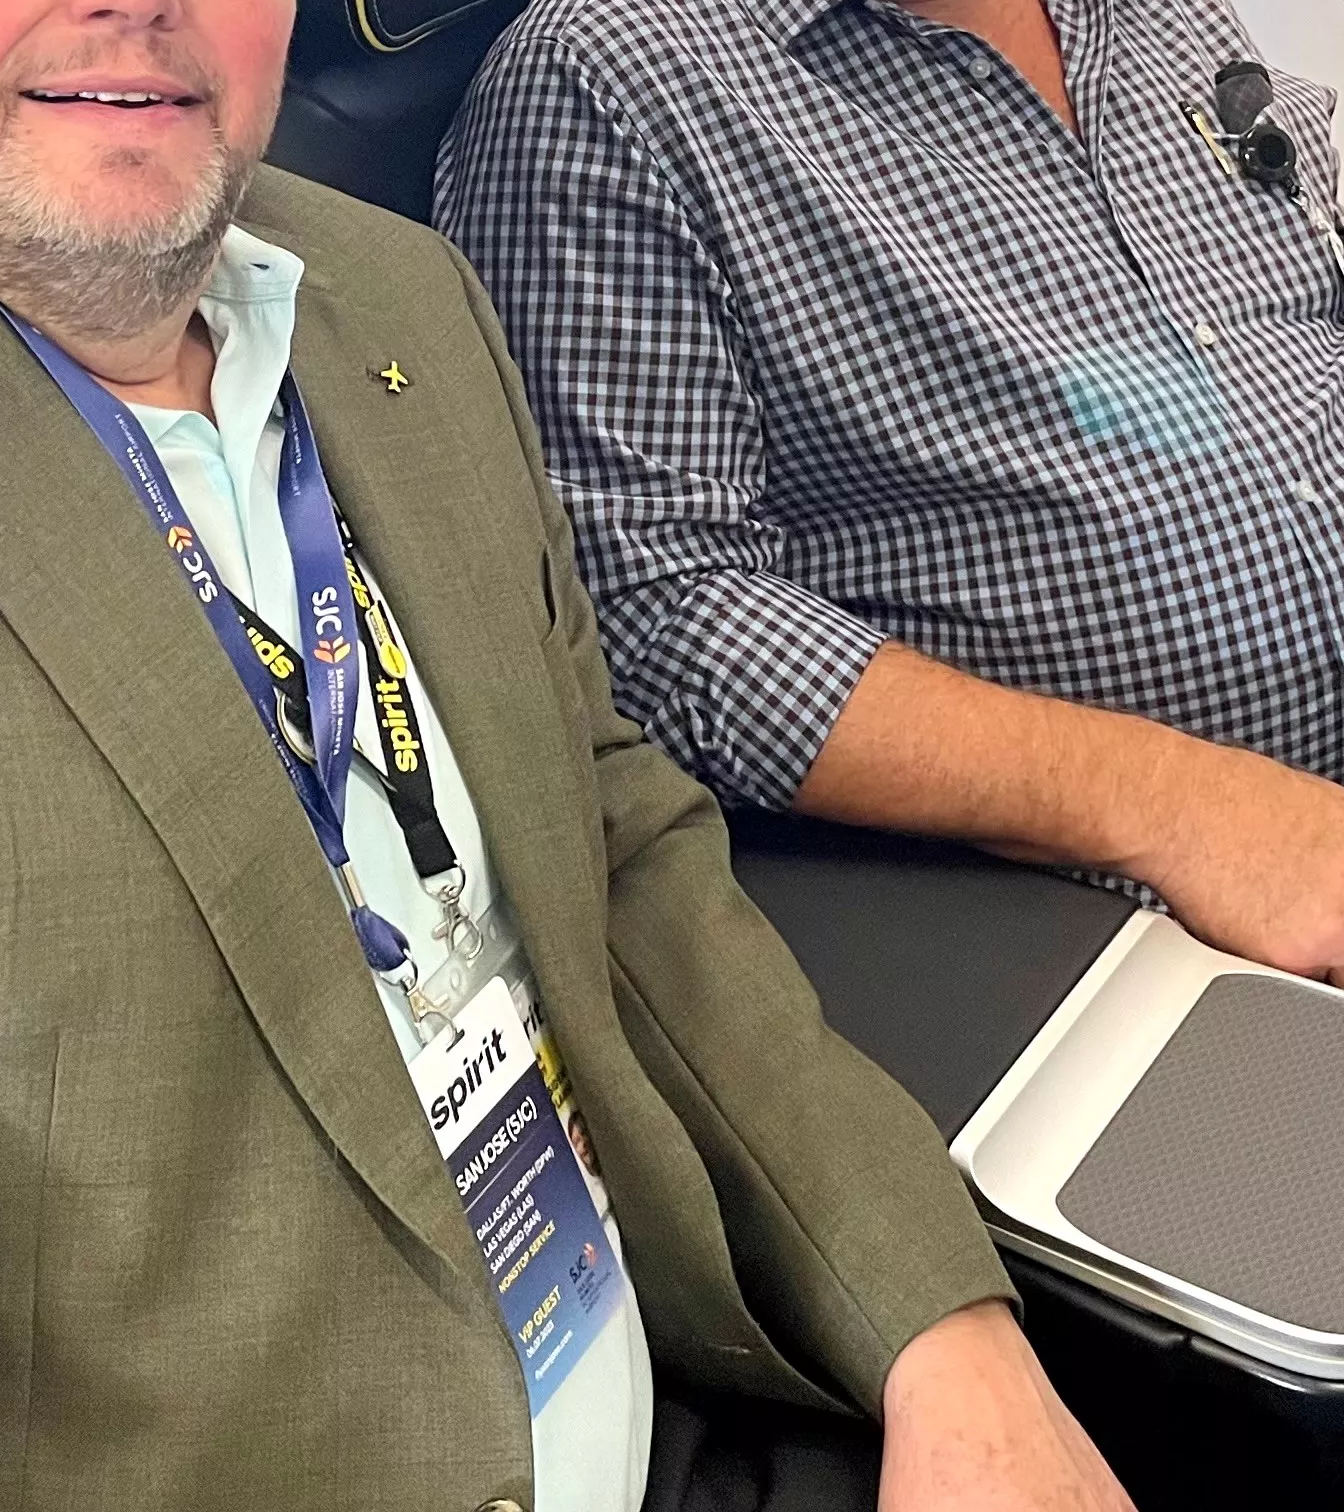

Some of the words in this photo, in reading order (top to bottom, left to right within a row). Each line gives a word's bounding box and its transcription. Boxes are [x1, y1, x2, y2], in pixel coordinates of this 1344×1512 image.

[182, 551, 219, 603] SJC
[312, 586, 343, 636] SJC
[375, 678, 420, 773] spirit
[431, 1027, 506, 1131] spirit
[456, 1156, 485, 1196] SAN
[482, 1125, 511, 1170] JOSE
[505, 1095, 538, 1143] (SJC)
[518, 1319, 534, 1344] VIP
[532, 1284, 562, 1327] GUEST
